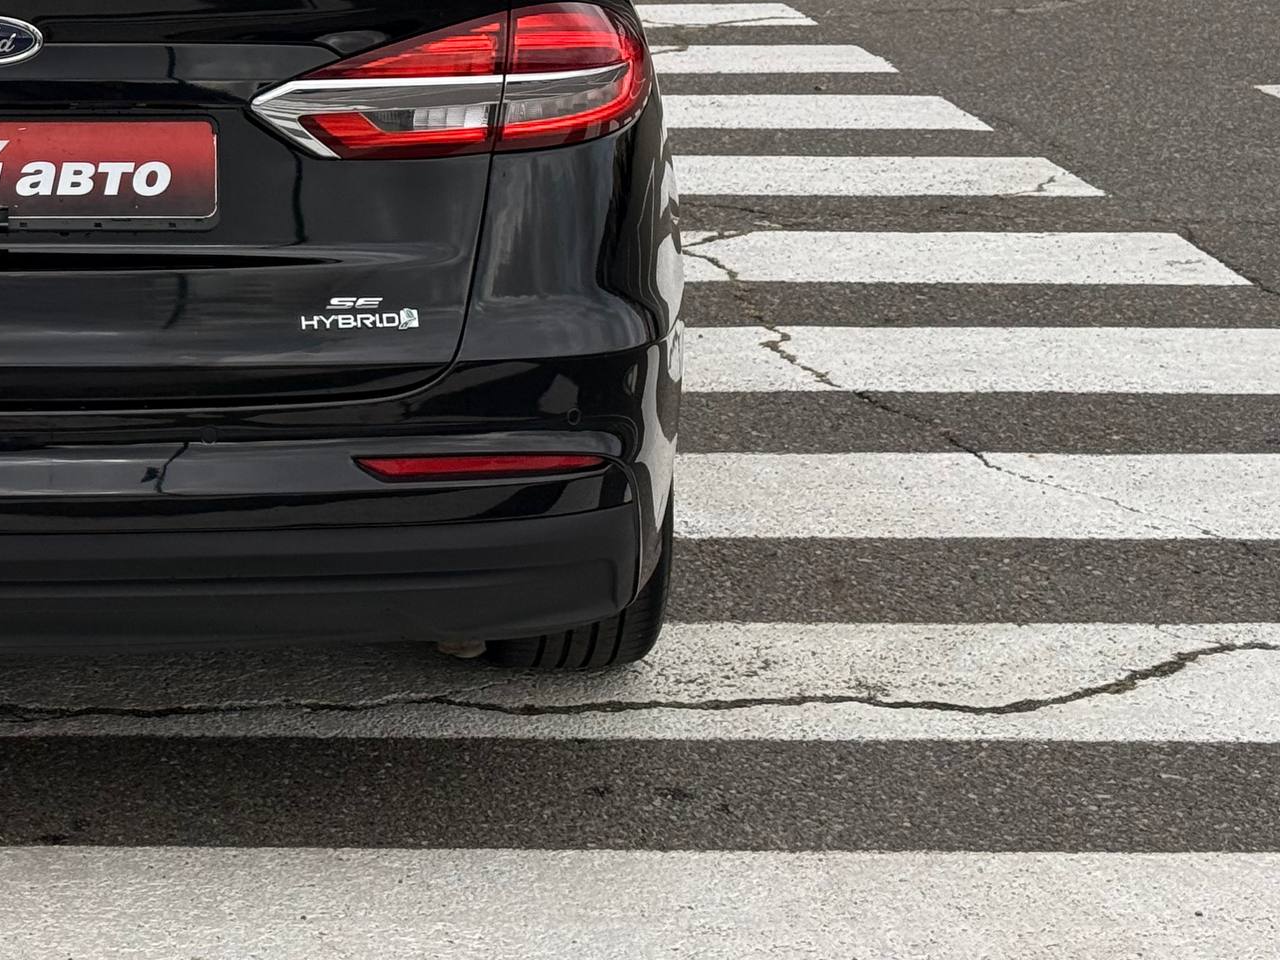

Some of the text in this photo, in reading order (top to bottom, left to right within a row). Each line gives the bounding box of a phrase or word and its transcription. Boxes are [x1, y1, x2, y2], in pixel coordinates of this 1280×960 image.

[15, 161, 172, 197] авто
[325, 296, 384, 310] SE
[300, 313, 400, 330] HYBRID
